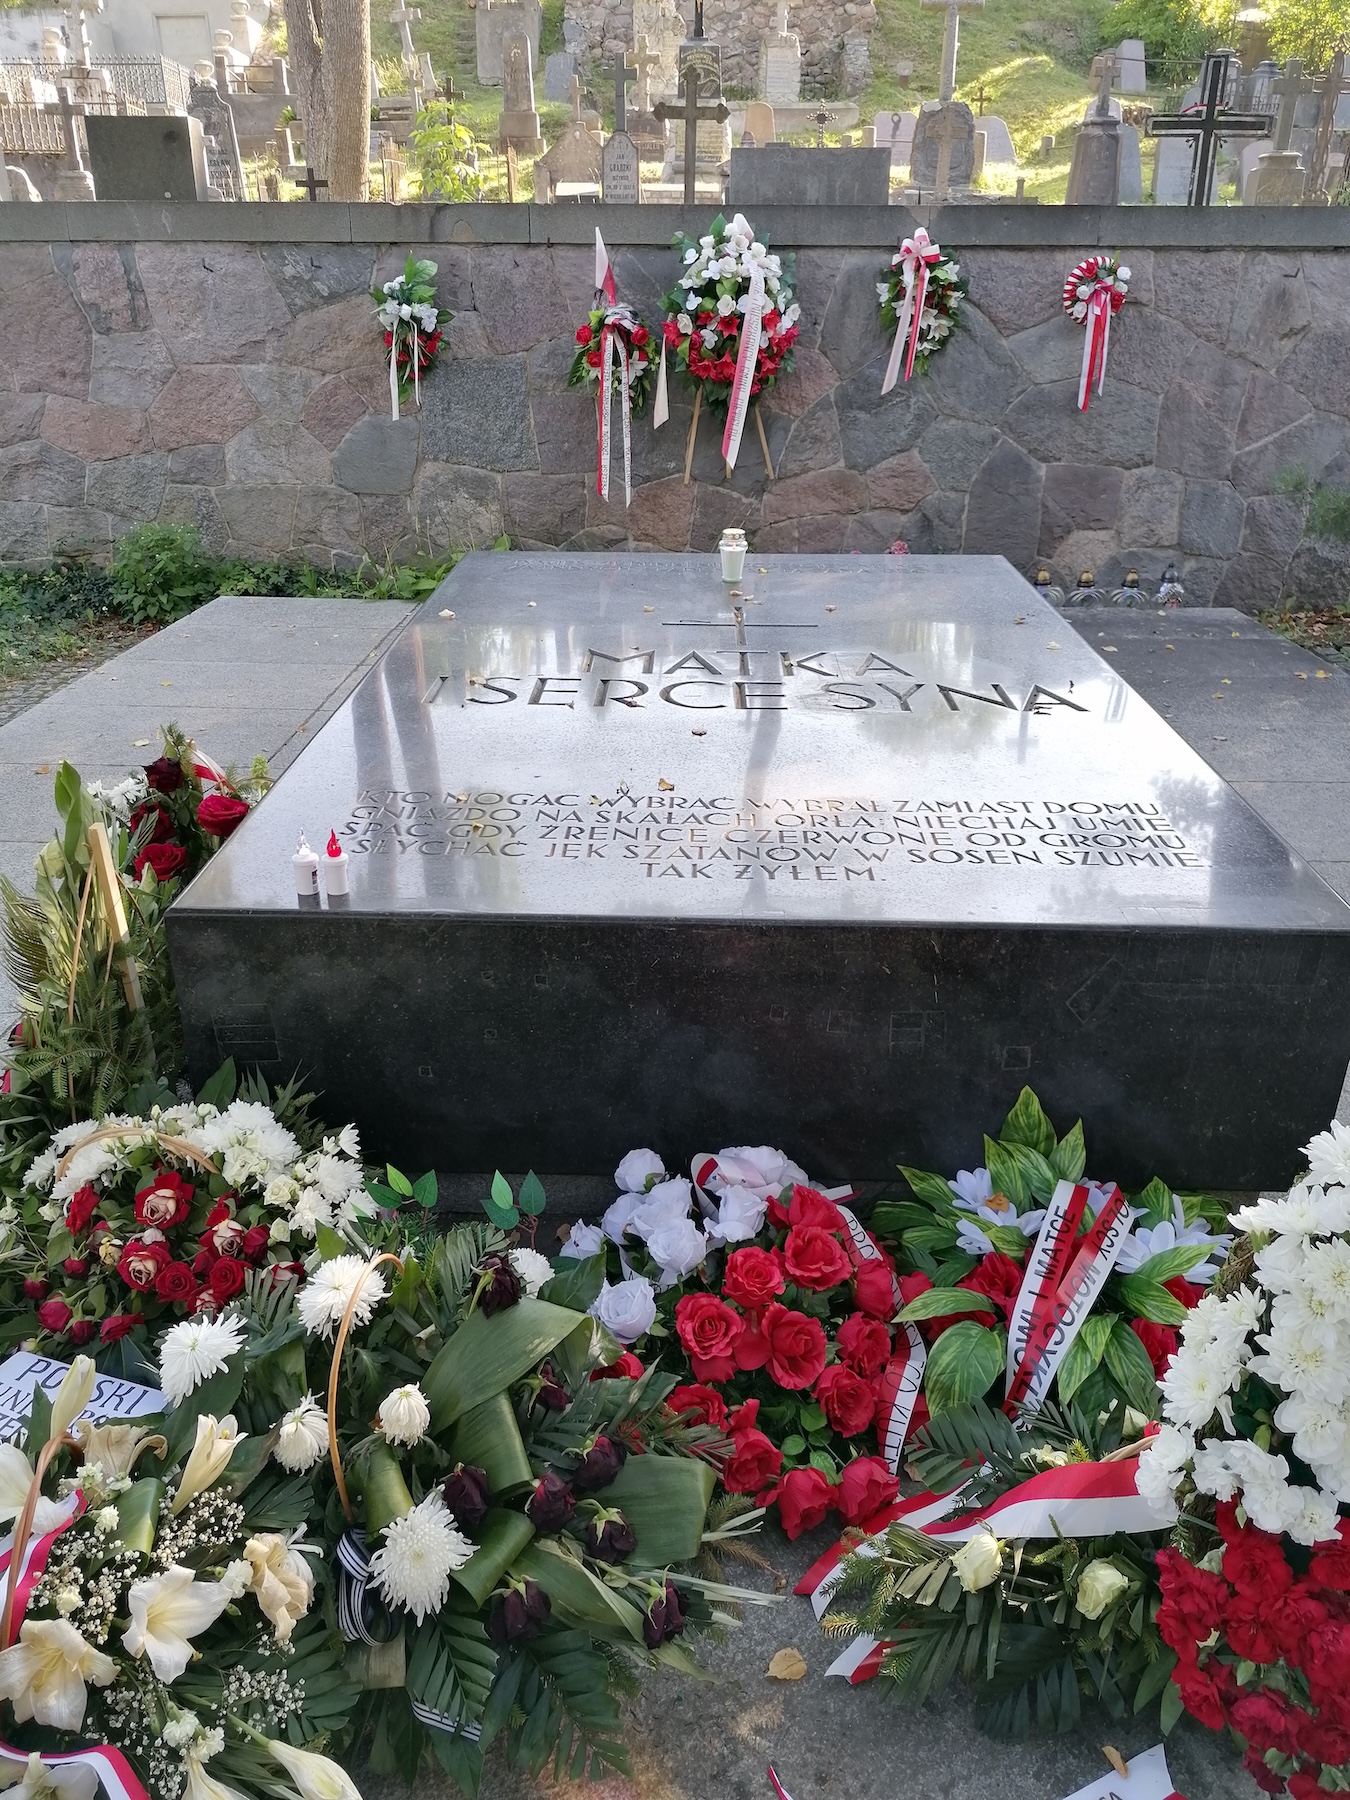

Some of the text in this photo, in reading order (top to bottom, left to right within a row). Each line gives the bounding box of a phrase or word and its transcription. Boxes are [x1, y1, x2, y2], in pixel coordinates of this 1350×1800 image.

[581, 648, 914, 677] MATKA
[466, 676, 788, 710] SERCE
[821, 681, 1091, 713] SYNA
[358, 790, 433, 804] KTO
[746, 798, 887, 813] WYBRAŁ
[893, 800, 1033, 814] ZAMIAST
[1043, 801, 1159, 816] DOMU
[352, 805, 521, 822] GNIAZDO
[535, 809, 584, 823] NA
[595, 810, 757, 827] SKAŁACH
[892, 815, 1057, 830] NIECHAJ
[1072, 817, 1176, 832] UMIE
[339, 821, 434, 837] SPAĆ
[447, 823, 527, 839] GDY
[724, 829, 953, 846] CZERWONE
[966, 832, 1027, 847] OD
[1039, 833, 1186, 849] GROMU
[351, 839, 527, 857] SŁYCHAĆ
[544, 843, 609, 860] JĘK
[623, 845, 838, 862] SZATANÓW
[853, 848, 889, 863] W
[907, 849, 1043, 864] SOSEN
[640, 862, 713, 879] TAK
[1034, 1205, 1076, 1281] MATCE
[15, 1358, 149, 1415] POSKI
